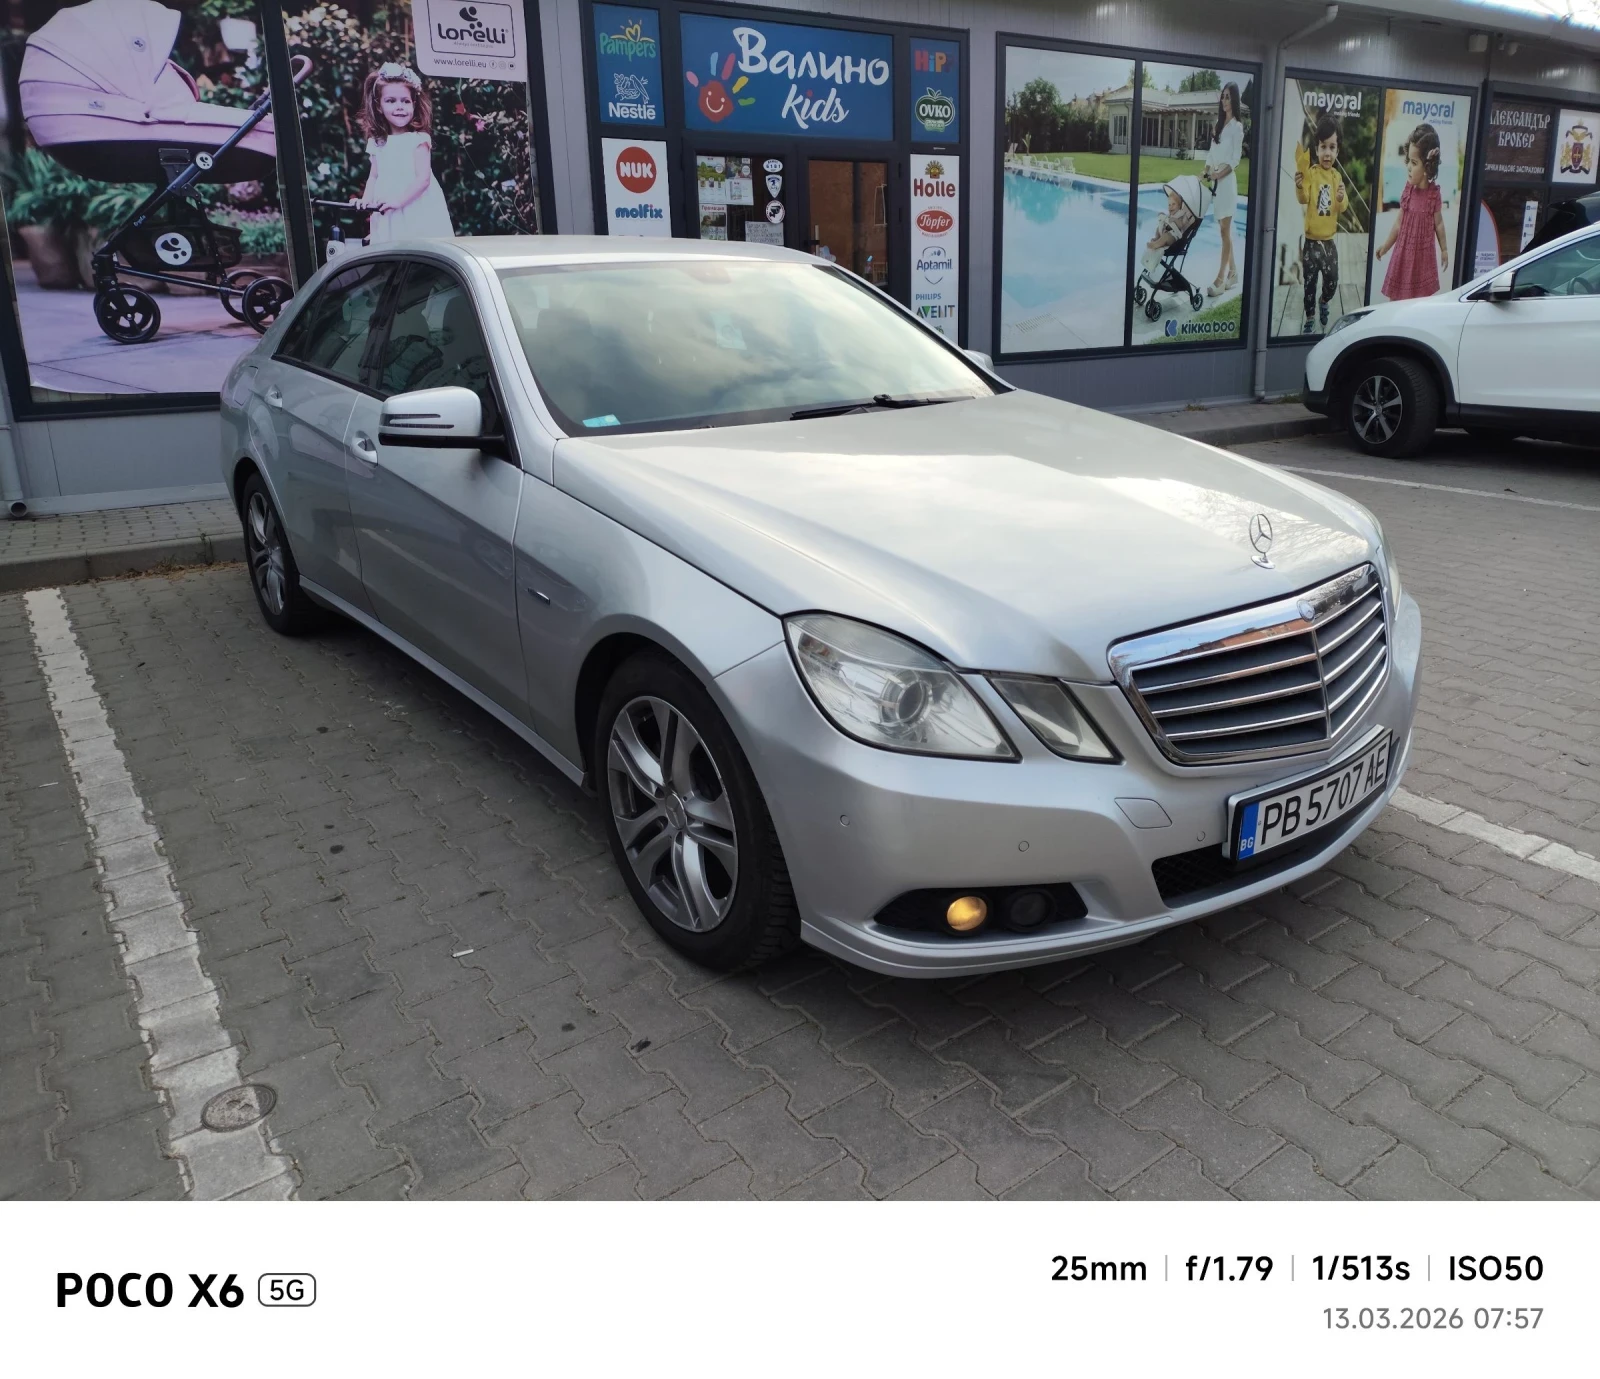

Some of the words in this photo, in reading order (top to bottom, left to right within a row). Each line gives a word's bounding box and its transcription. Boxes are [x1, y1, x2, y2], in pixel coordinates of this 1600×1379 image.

[438, 23, 506, 44] lorelli
[599, 32, 656, 62] Pampers
[732, 27, 889, 86] Валино
[434, 59, 487, 68] www.lorelli.eu
[781, 84, 850, 129] kids
[919, 103, 951, 118] OVKO
[1303, 91, 1362, 112] mayoral
[1403, 100, 1455, 120] mayoral
[620, 161, 654, 178] NUK
[913, 178, 956, 197] Holle
[615, 204, 663, 219] molfix
[916, 258, 952, 272] Aptamil
[1261, 795, 1301, 845] PB
[1305, 760, 1364, 826] 5707
[1363, 742, 1388, 793] AE
[1240, 836, 1254, 851] BG
